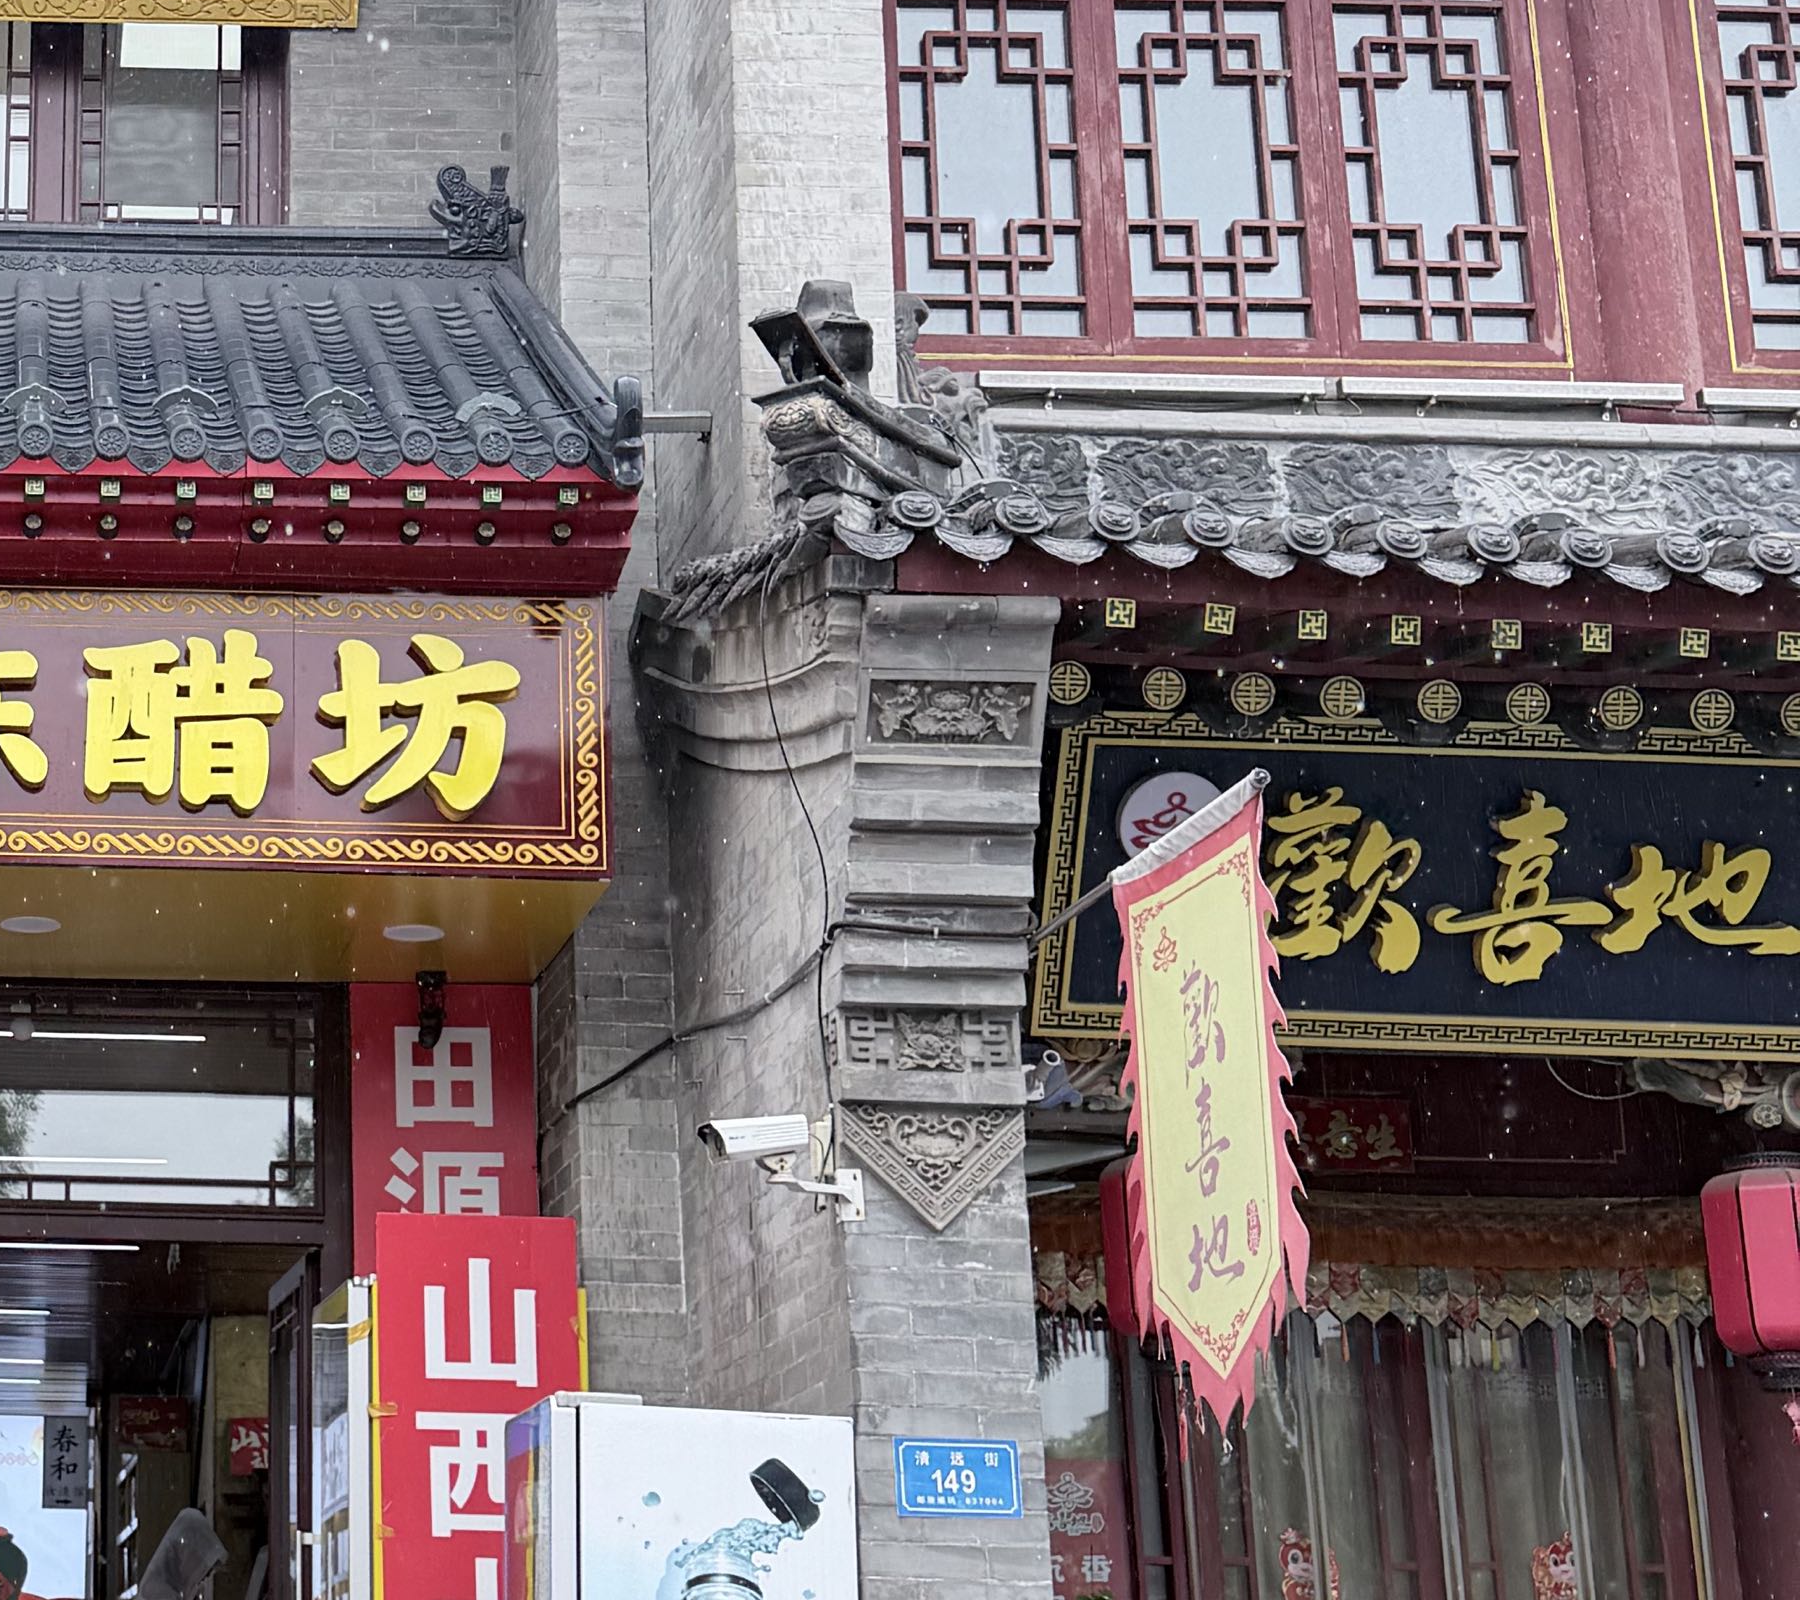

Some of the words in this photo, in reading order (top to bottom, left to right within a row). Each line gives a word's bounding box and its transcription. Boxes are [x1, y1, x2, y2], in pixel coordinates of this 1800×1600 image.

[383, 1025, 506, 1217] 田源
[49, 1424, 80, 1482] 春和
[914, 1449, 1000, 1468] 清远街
[930, 1468, 977, 1495] 149
